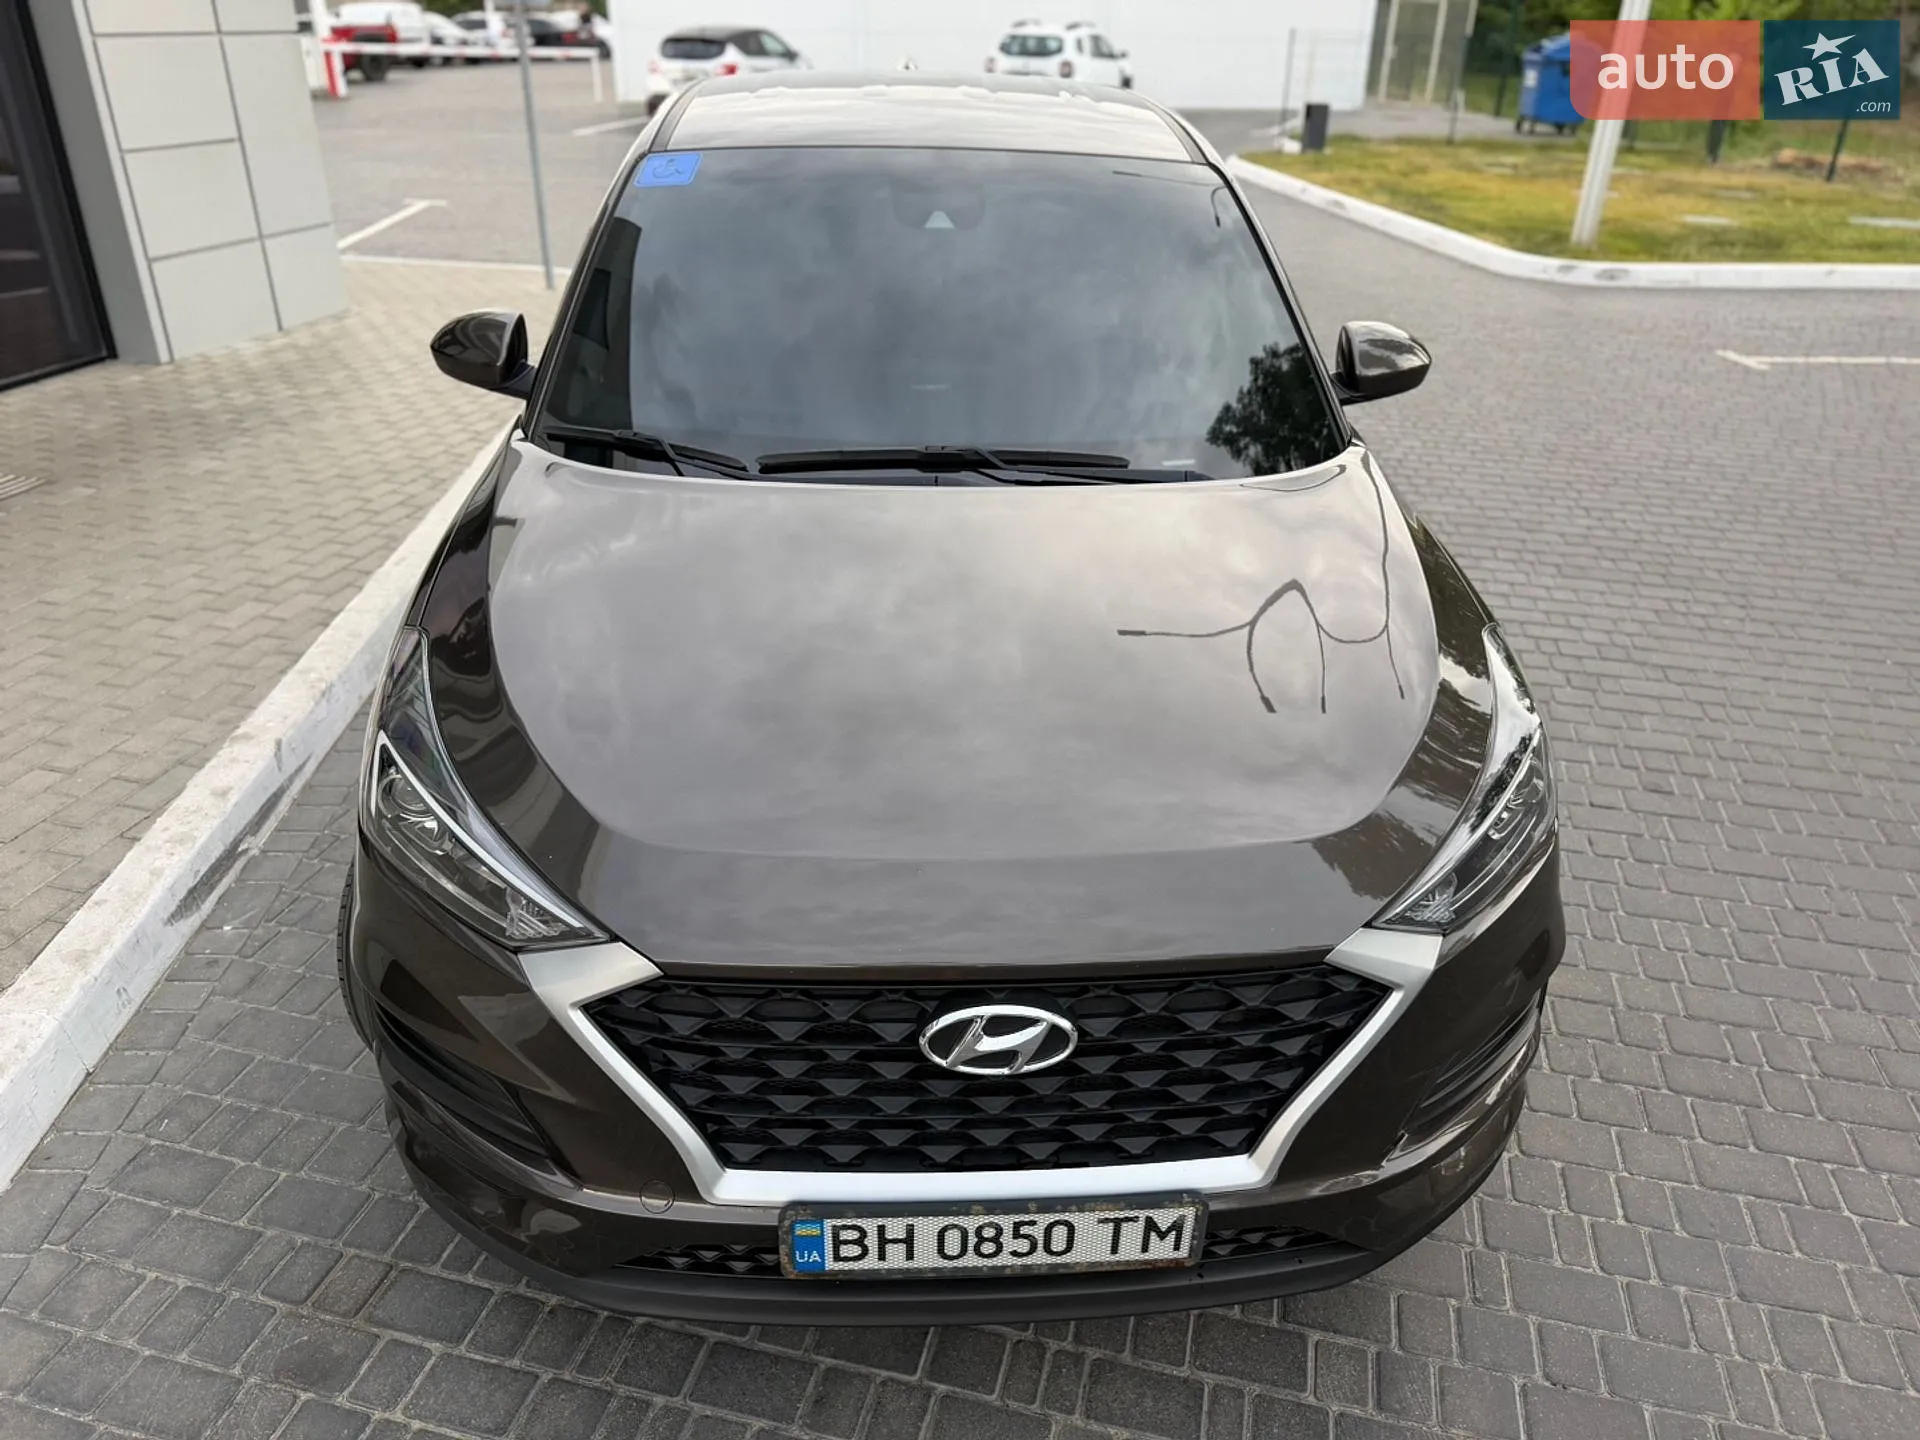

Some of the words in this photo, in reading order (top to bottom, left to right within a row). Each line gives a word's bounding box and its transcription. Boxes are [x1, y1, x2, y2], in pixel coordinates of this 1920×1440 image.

[831, 1223, 915, 1263] BH
[936, 1219, 1077, 1261] 0850
[1097, 1213, 1186, 1255] TM
[795, 1249, 821, 1264] UA
